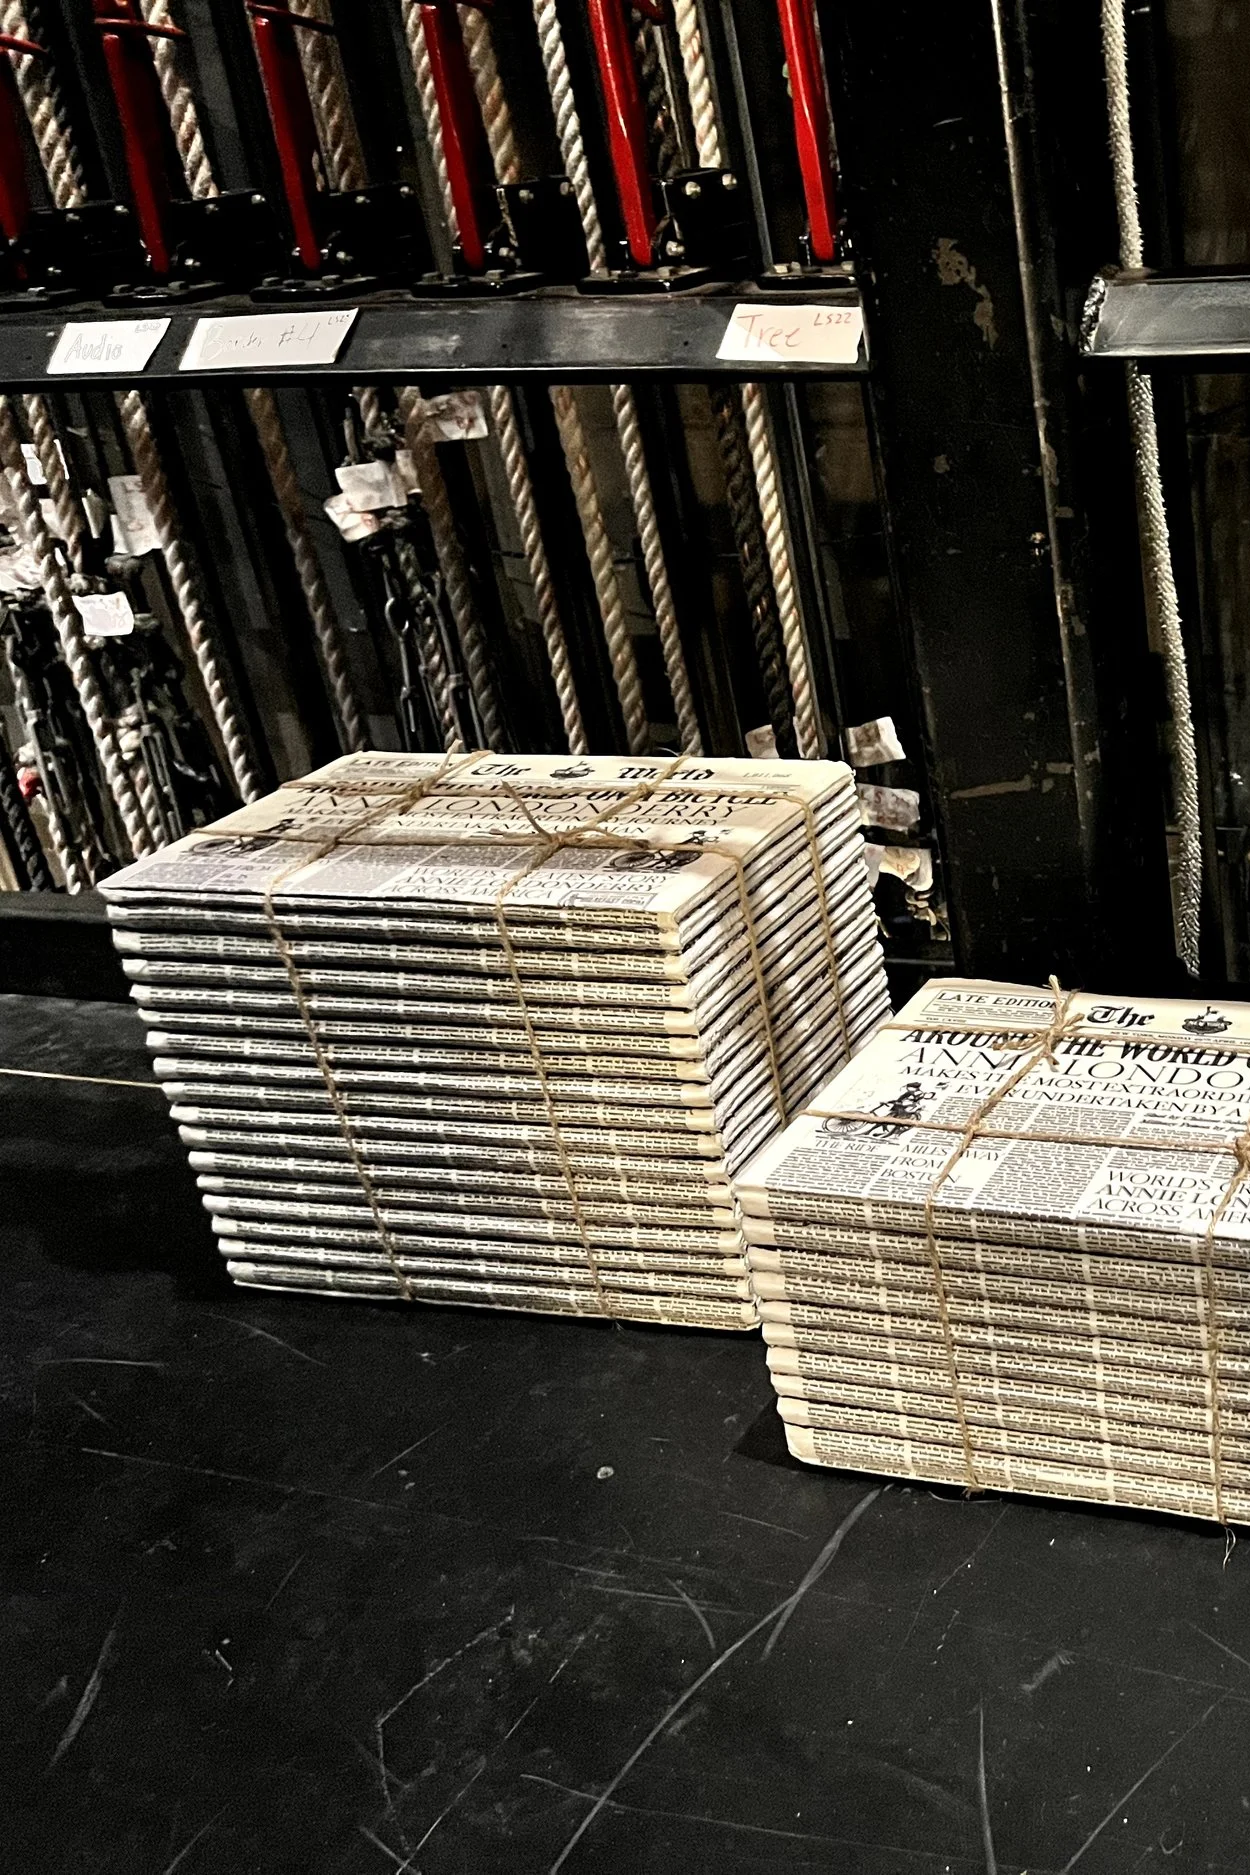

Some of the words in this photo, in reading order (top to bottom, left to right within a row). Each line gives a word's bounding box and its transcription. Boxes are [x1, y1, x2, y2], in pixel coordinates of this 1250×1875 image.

[813, 312, 852, 326] LS22
[737, 313, 801, 348] Tree
[64, 333, 122, 363] Audio
[471, 763, 531, 776] The
[617, 767, 715, 780] Wrld
[284, 795, 398, 808] ANNI
[470, 878, 661, 892] LODONDERRY
[937, 993, 988, 1004] LATE
[1087, 1005, 1155, 1027] The
[1057, 1035, 1106, 1057] HE
[1120, 1041, 1237, 1067] WORLD
[898, 1066, 977, 1080] MAKES
[1031, 1077, 1101, 1092] MOST
[1021, 1088, 1192, 1113] UNDERTAKEN
[1192, 1104, 1227, 1116] BY
[1228, 1107, 1243, 1117] A
[900, 1144, 949, 1156] MILES
[890, 1156, 945, 1169] FROM
[1096, 1184, 1187, 1202] ANNIE
[1087, 1198, 1184, 1217] ACROSS
